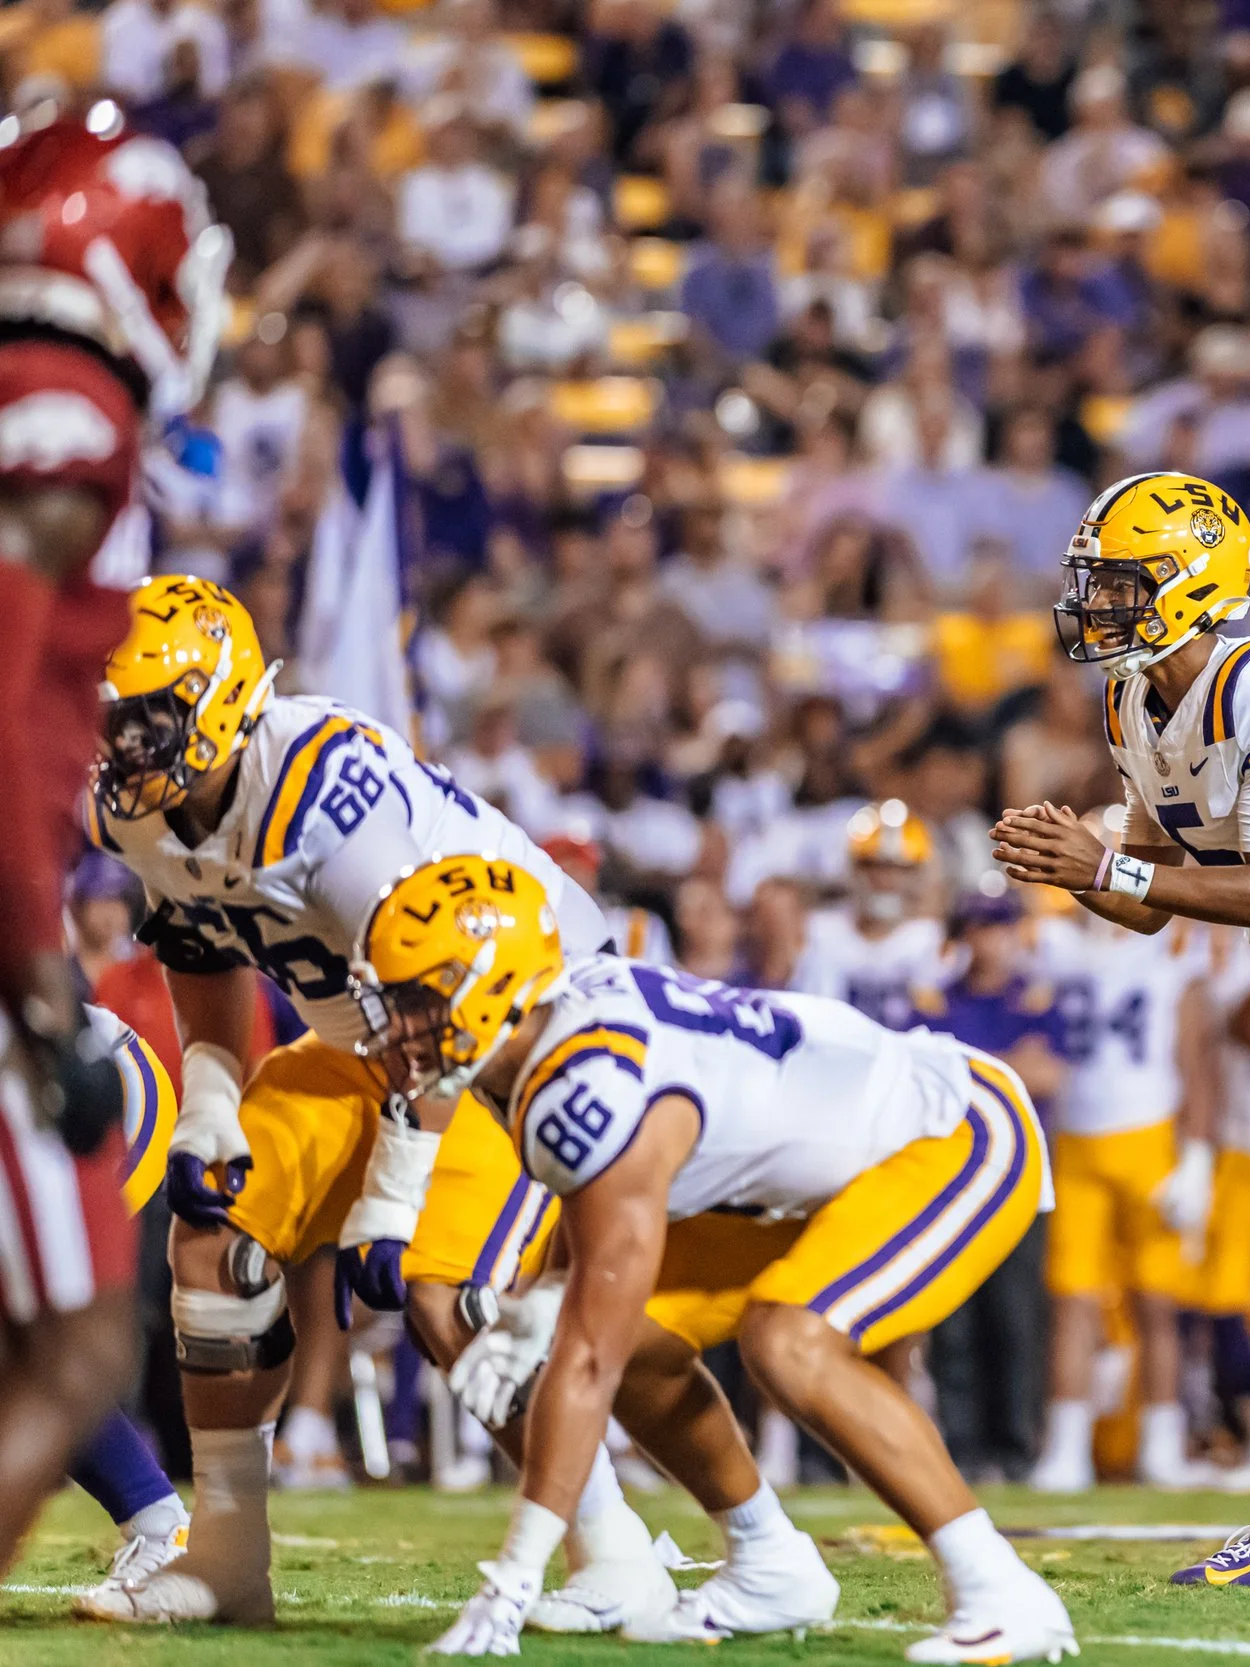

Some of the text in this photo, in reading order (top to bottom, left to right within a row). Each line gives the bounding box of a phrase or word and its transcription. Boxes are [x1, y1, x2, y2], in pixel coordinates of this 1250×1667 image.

[1149, 484, 1240, 526] LSU
[138, 580, 233, 624] LSU
[319, 757, 384, 836] 66
[1161, 785, 1180, 798] LSU
[402, 866, 515, 924] LSU
[536, 1082, 613, 1172] 86
